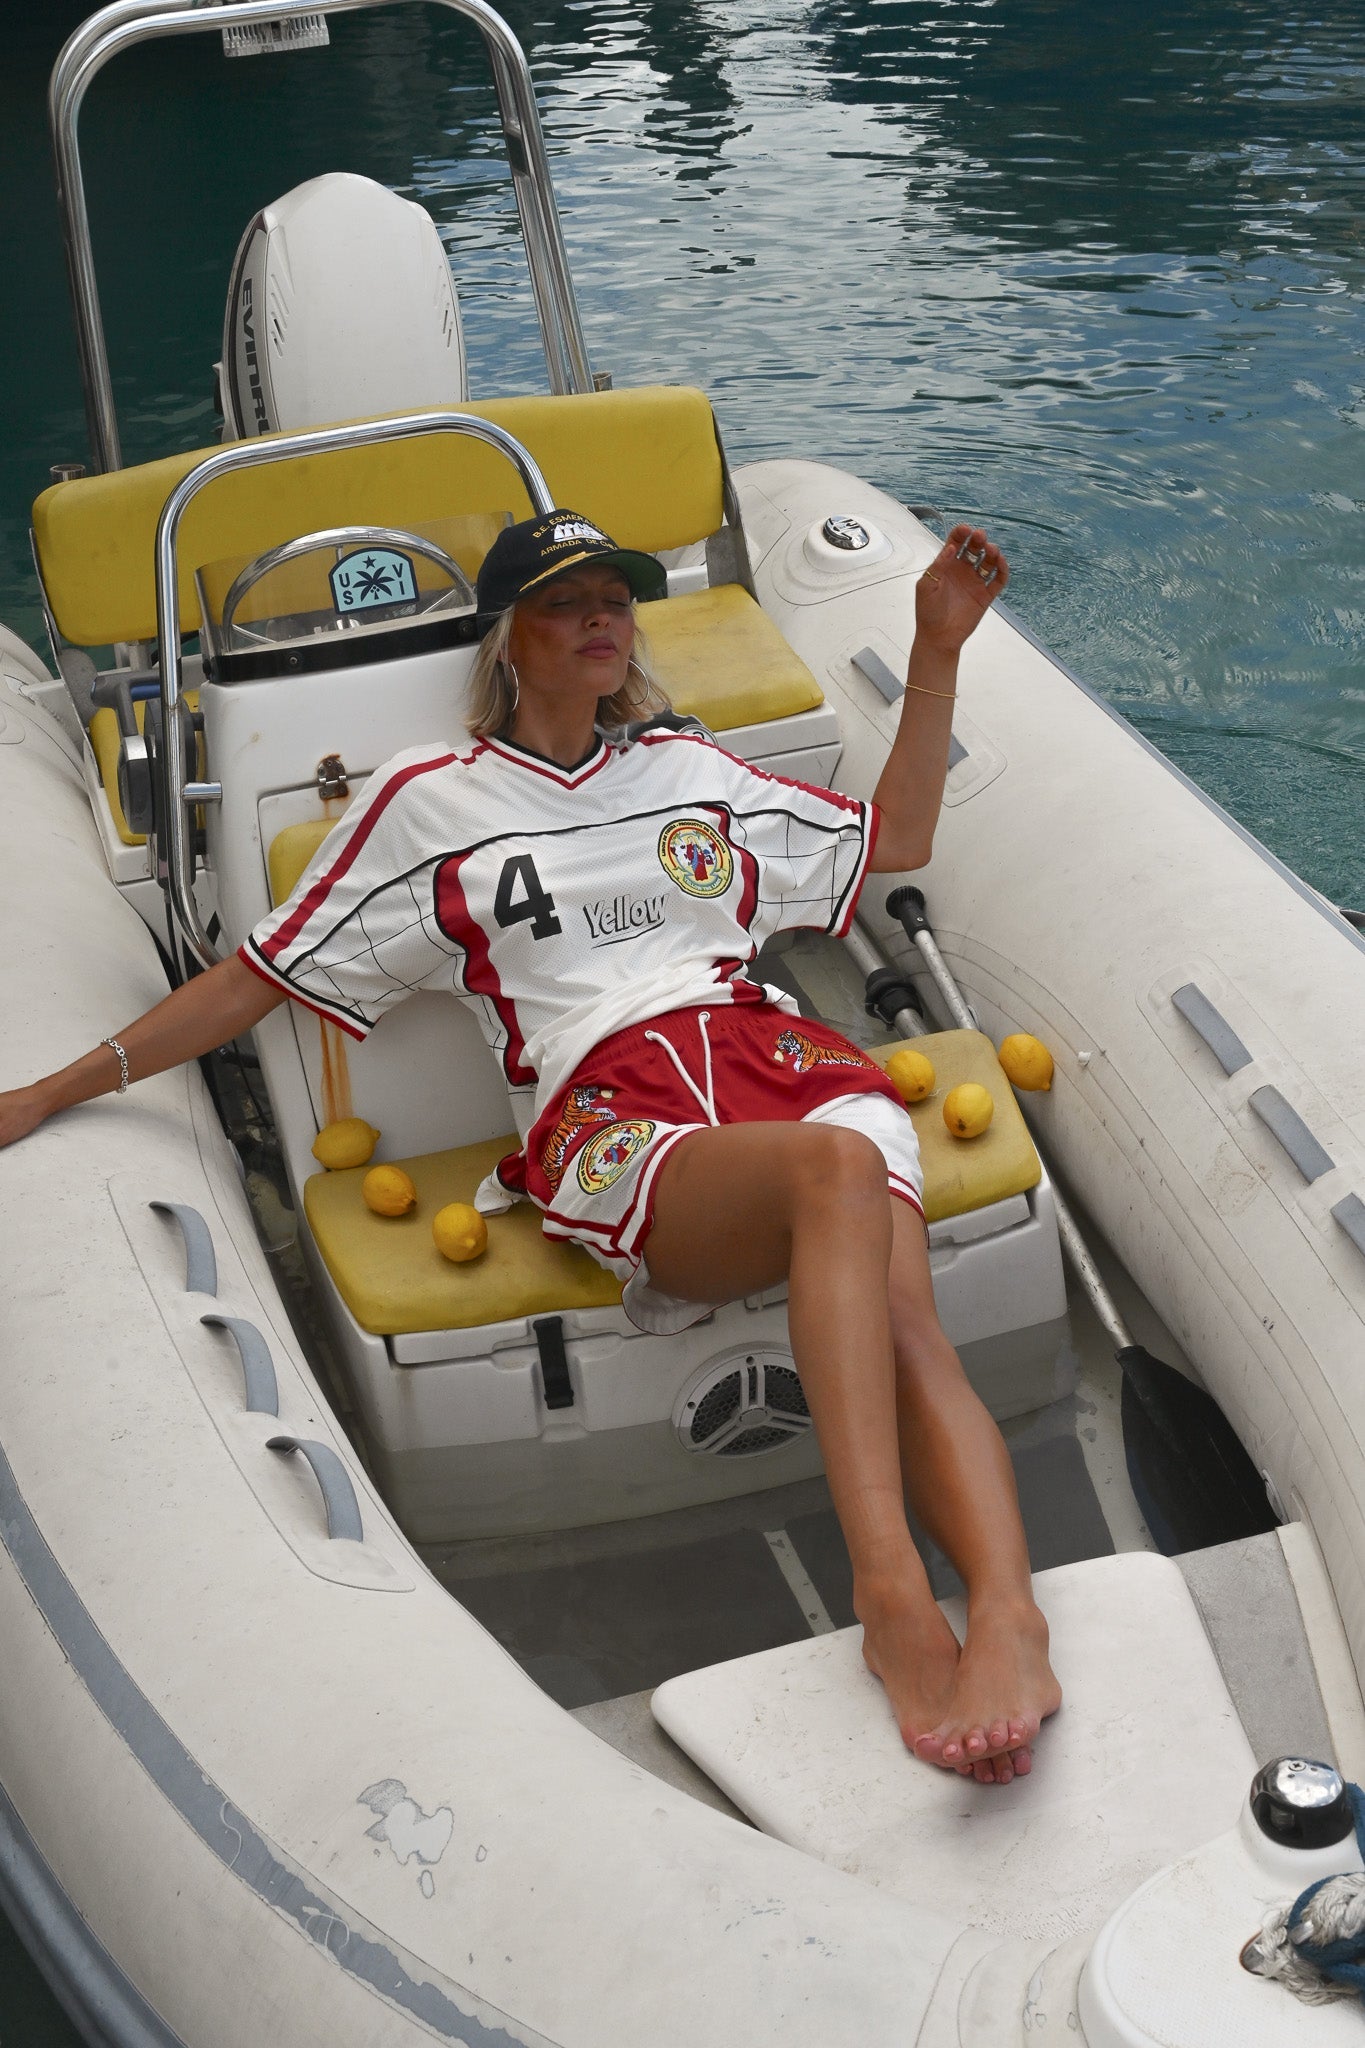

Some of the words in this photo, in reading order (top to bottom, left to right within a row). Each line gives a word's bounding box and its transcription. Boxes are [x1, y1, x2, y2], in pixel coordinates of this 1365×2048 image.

[532, 524, 550, 539] B.E.
[540, 539, 582, 557] ARMADA
[493, 853, 563, 941] 4
[582, 893, 669, 939] Yellow
